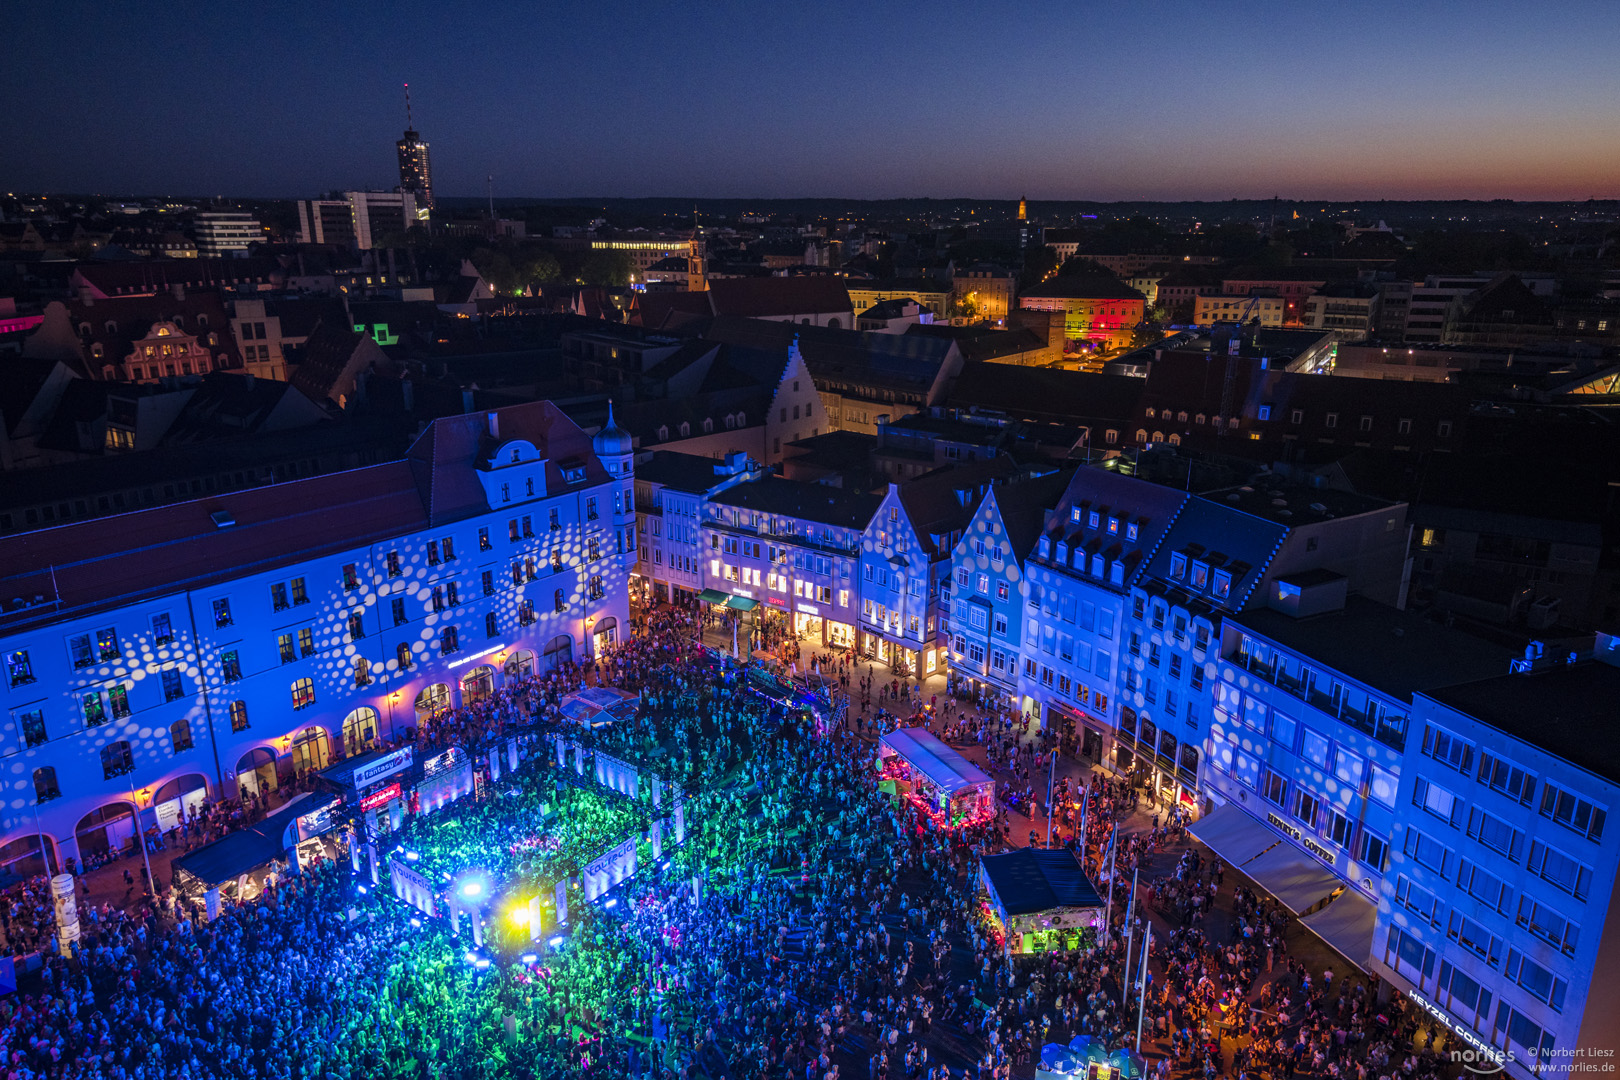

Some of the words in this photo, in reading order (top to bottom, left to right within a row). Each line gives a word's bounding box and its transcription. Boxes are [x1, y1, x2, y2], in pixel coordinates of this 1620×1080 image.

[365, 761, 395, 779] fantasy
[588, 842, 634, 877] Faurecia
[1267, 812, 1302, 841] HENRY'S
[1303, 837, 1336, 865] COFFEE
[1408, 989, 1452, 1028] HEYZEL
[1455, 1024, 1504, 1067] COFFEE
